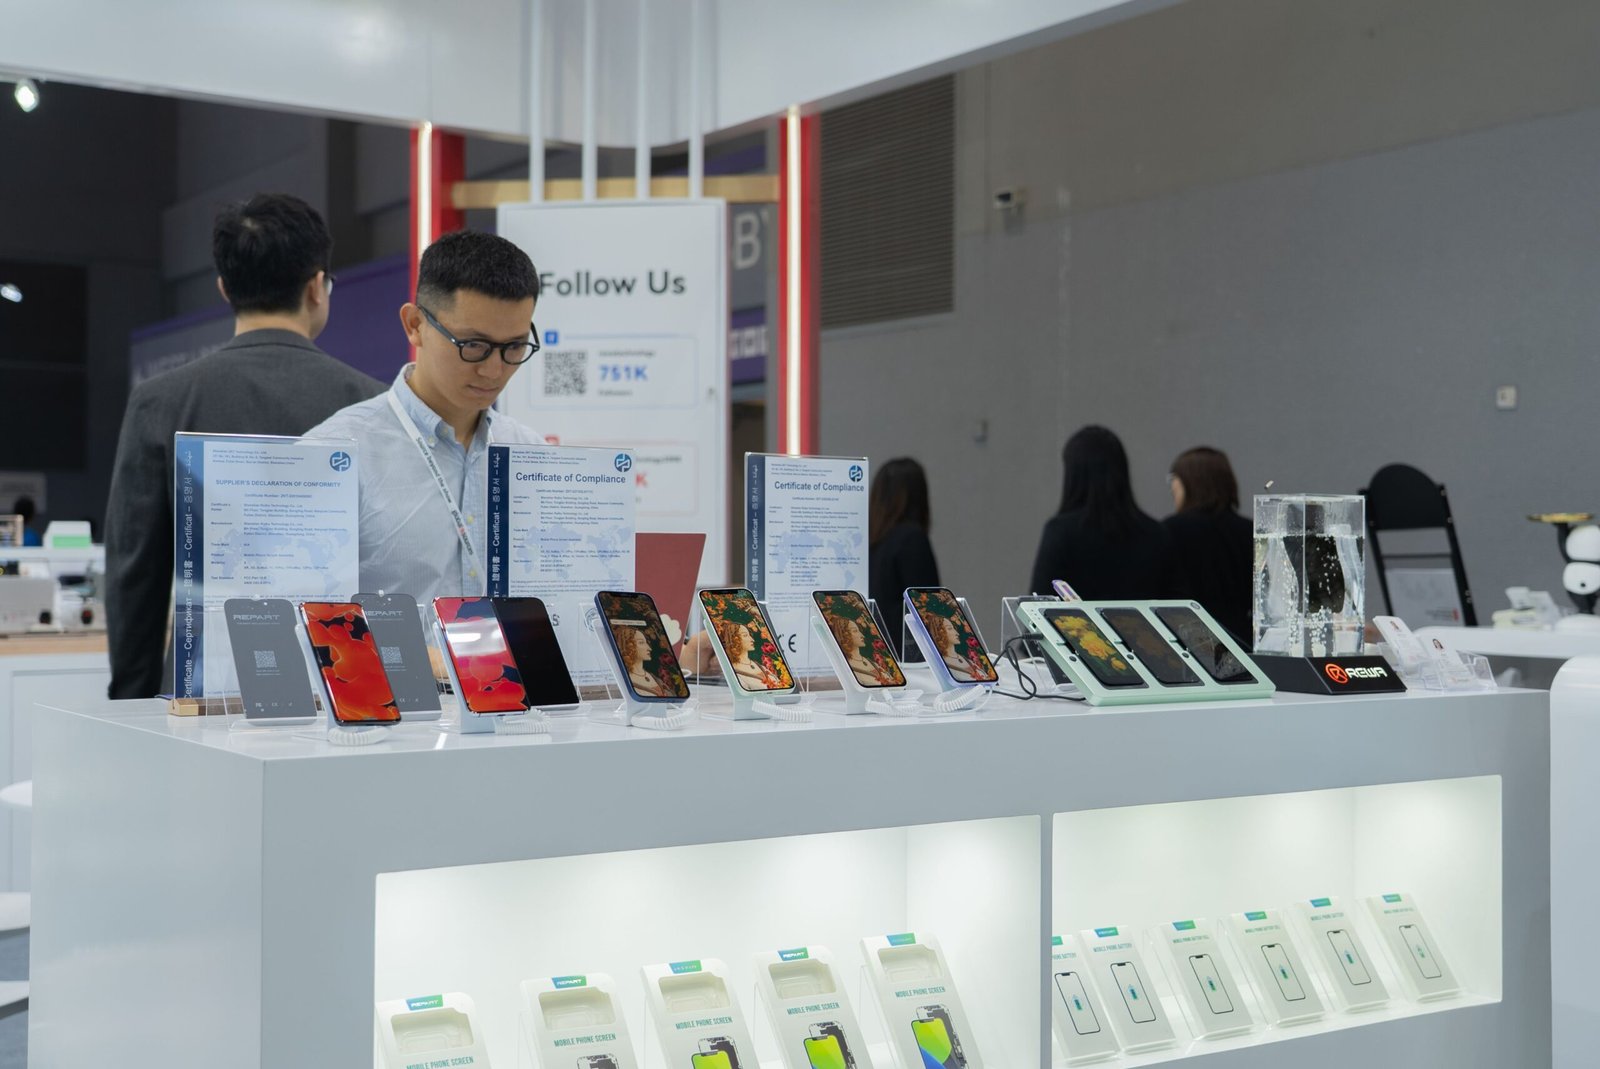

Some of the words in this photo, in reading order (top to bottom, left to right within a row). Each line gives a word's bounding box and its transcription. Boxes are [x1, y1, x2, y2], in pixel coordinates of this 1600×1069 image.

[540, 270, 636, 296] Follow
[649, 271, 686, 294] Us
[599, 364, 648, 382] 751K
[416, 437, 428, 456] Source
[427, 456, 440, 477] beyond
[444, 488, 452, 503] show
[516, 472, 562, 482] Certificate
[564, 473, 573, 482] of
[576, 474, 626, 484] Compliance
[774, 481, 811, 490] Certificate
[813, 482, 821, 491] of
[823, 483, 864, 493] Compliance
[184, 514, 193, 549] Certificat
[1345, 666, 1387, 678] REWA
[787, 1006, 805, 1015] MOBILE
[805, 1004, 821, 1012] PHONE
[676, 1020, 696, 1029] MOBILE
[696, 1018, 712, 1027] PHONE
[712, 1016, 732, 1024] SCREEN
[554, 1038, 575, 1047] MOBILE
[576, 1036, 594, 1044] PHONE
[430, 1059, 449, 1068] PHONE
[450, 1056, 474, 1066] SCREEN
